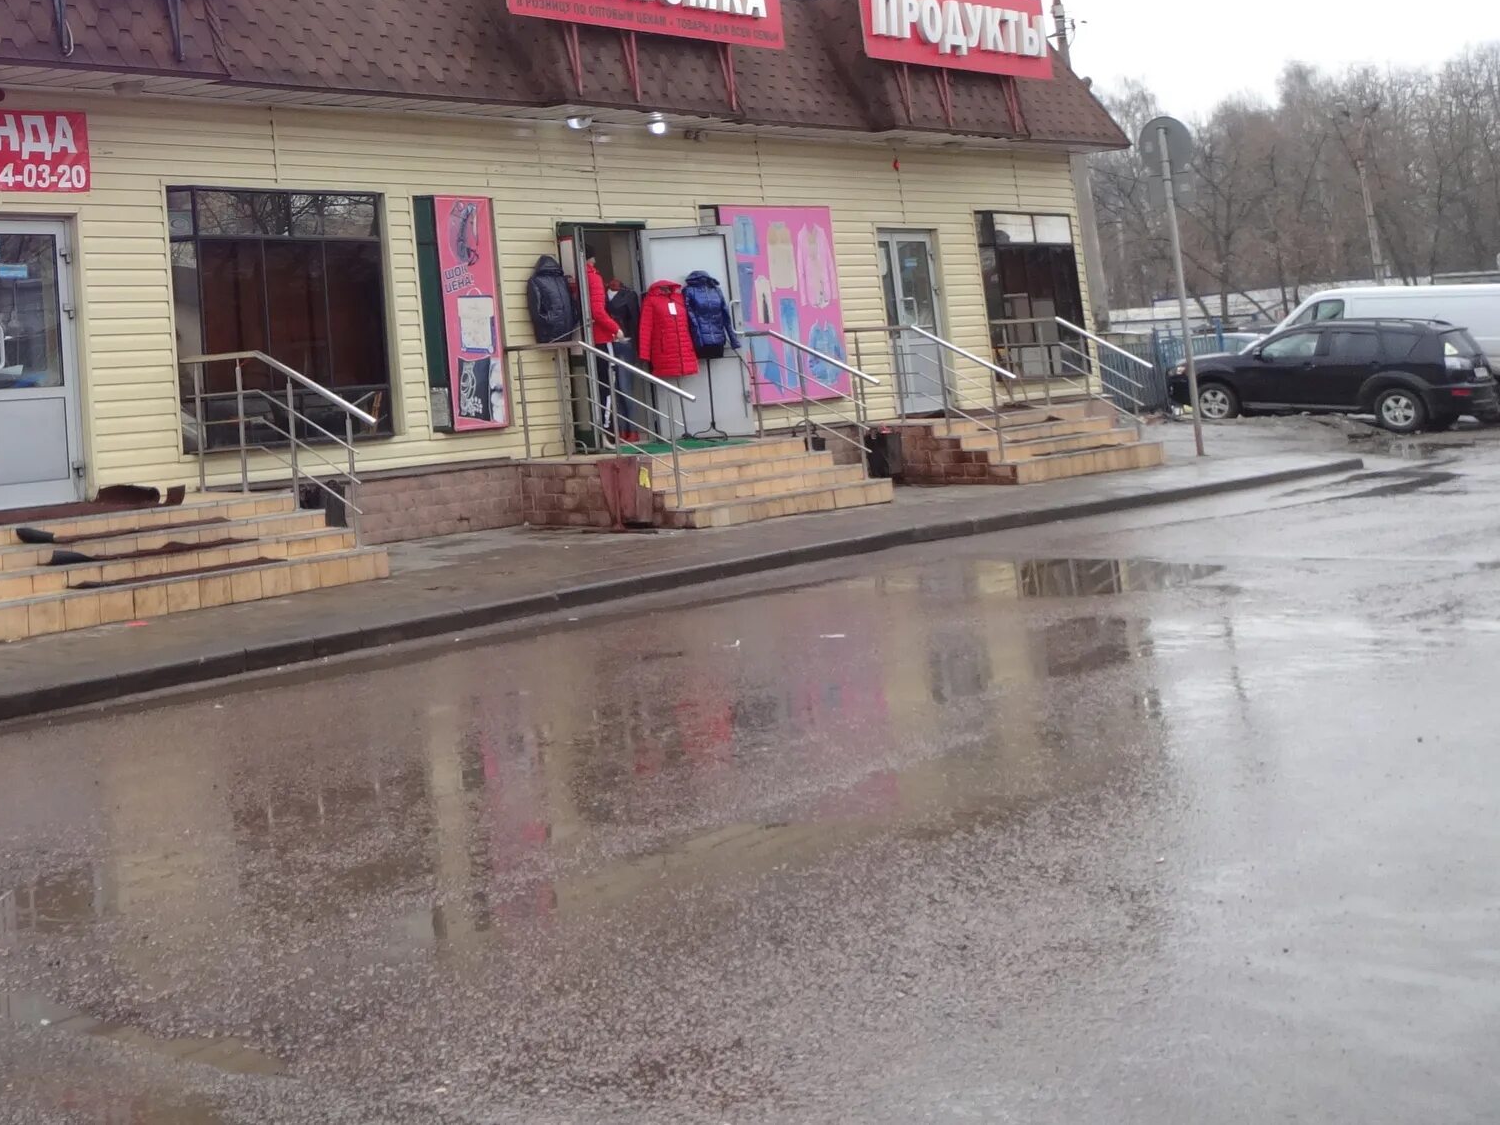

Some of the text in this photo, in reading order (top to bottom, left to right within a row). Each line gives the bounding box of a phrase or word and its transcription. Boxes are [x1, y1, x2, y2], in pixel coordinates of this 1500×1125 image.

[573, 3, 586, 14] ПО
[588, 5, 634, 22] ОПТОВЫМ
[444, 265, 469, 280] ШОК
[445, 275, 474, 293] ЦЕНА!
